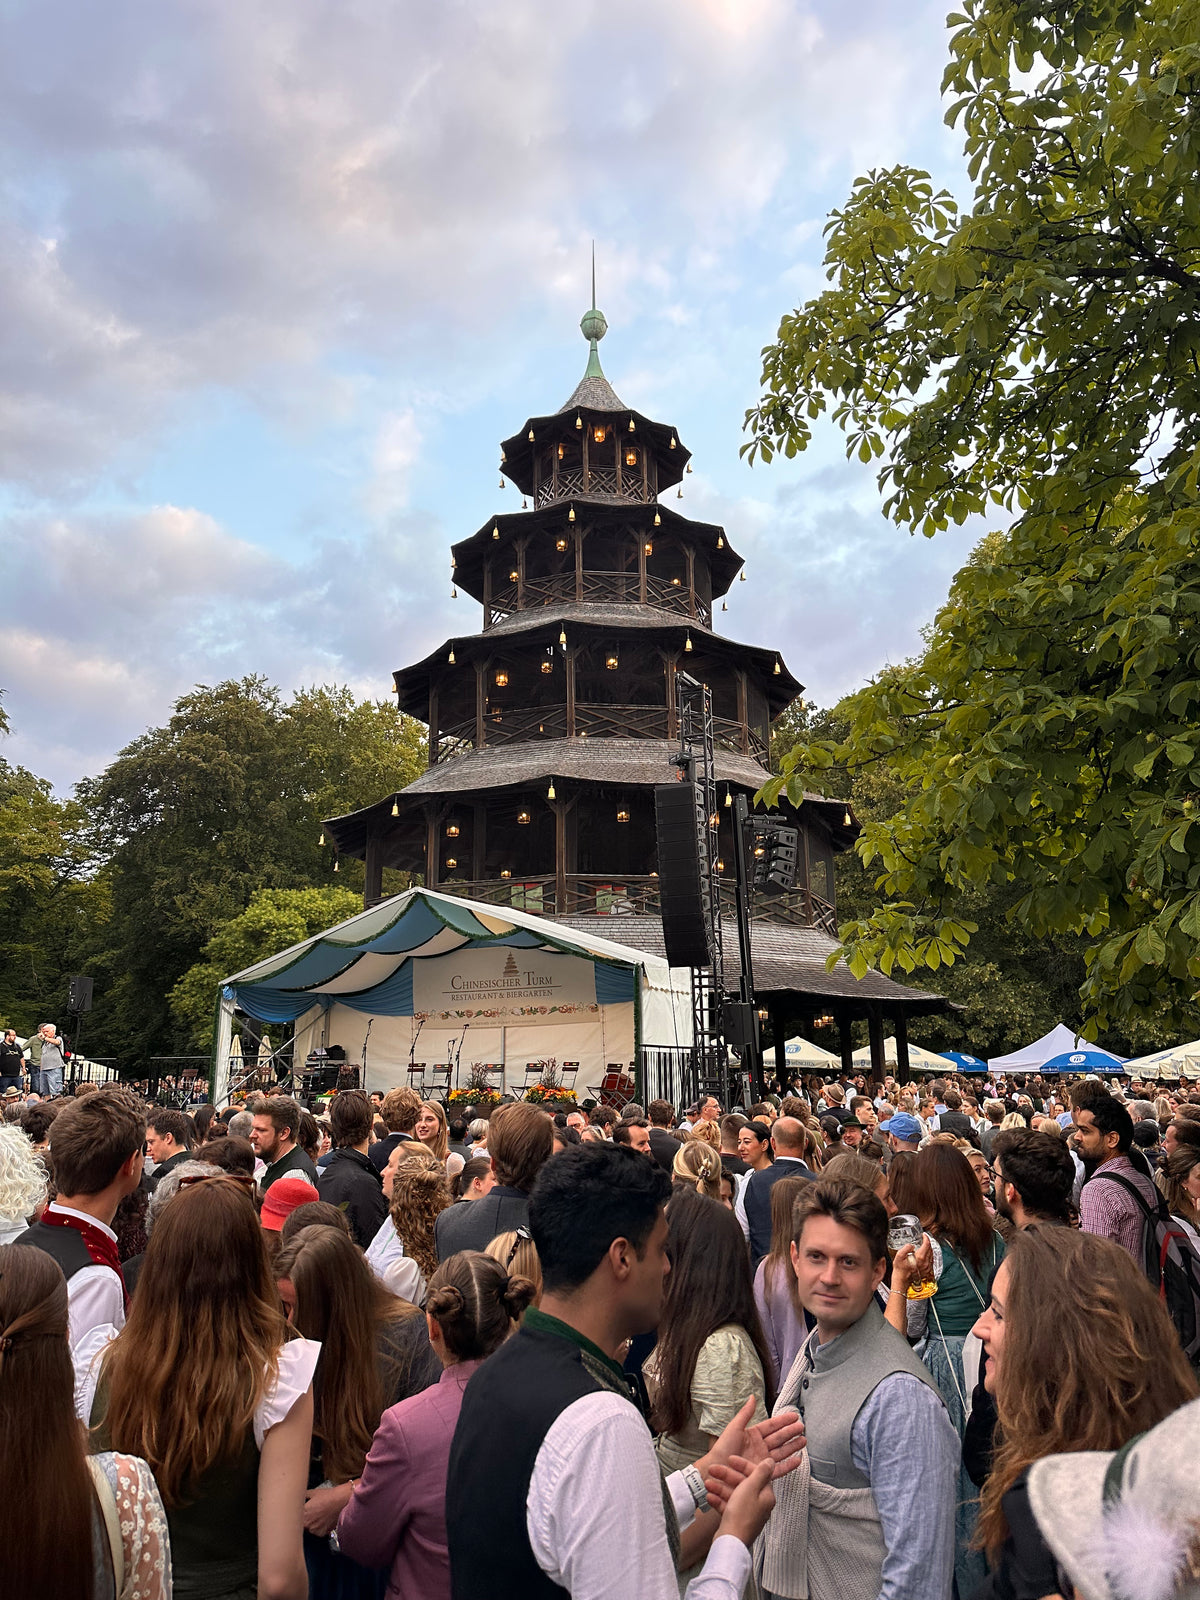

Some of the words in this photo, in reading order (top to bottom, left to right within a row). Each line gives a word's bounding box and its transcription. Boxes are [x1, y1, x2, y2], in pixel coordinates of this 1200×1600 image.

[523, 971, 552, 986] TURM
[451, 992, 499, 1001] RESTAURANT
[506, 989, 553, 998] BIERGARTEN
